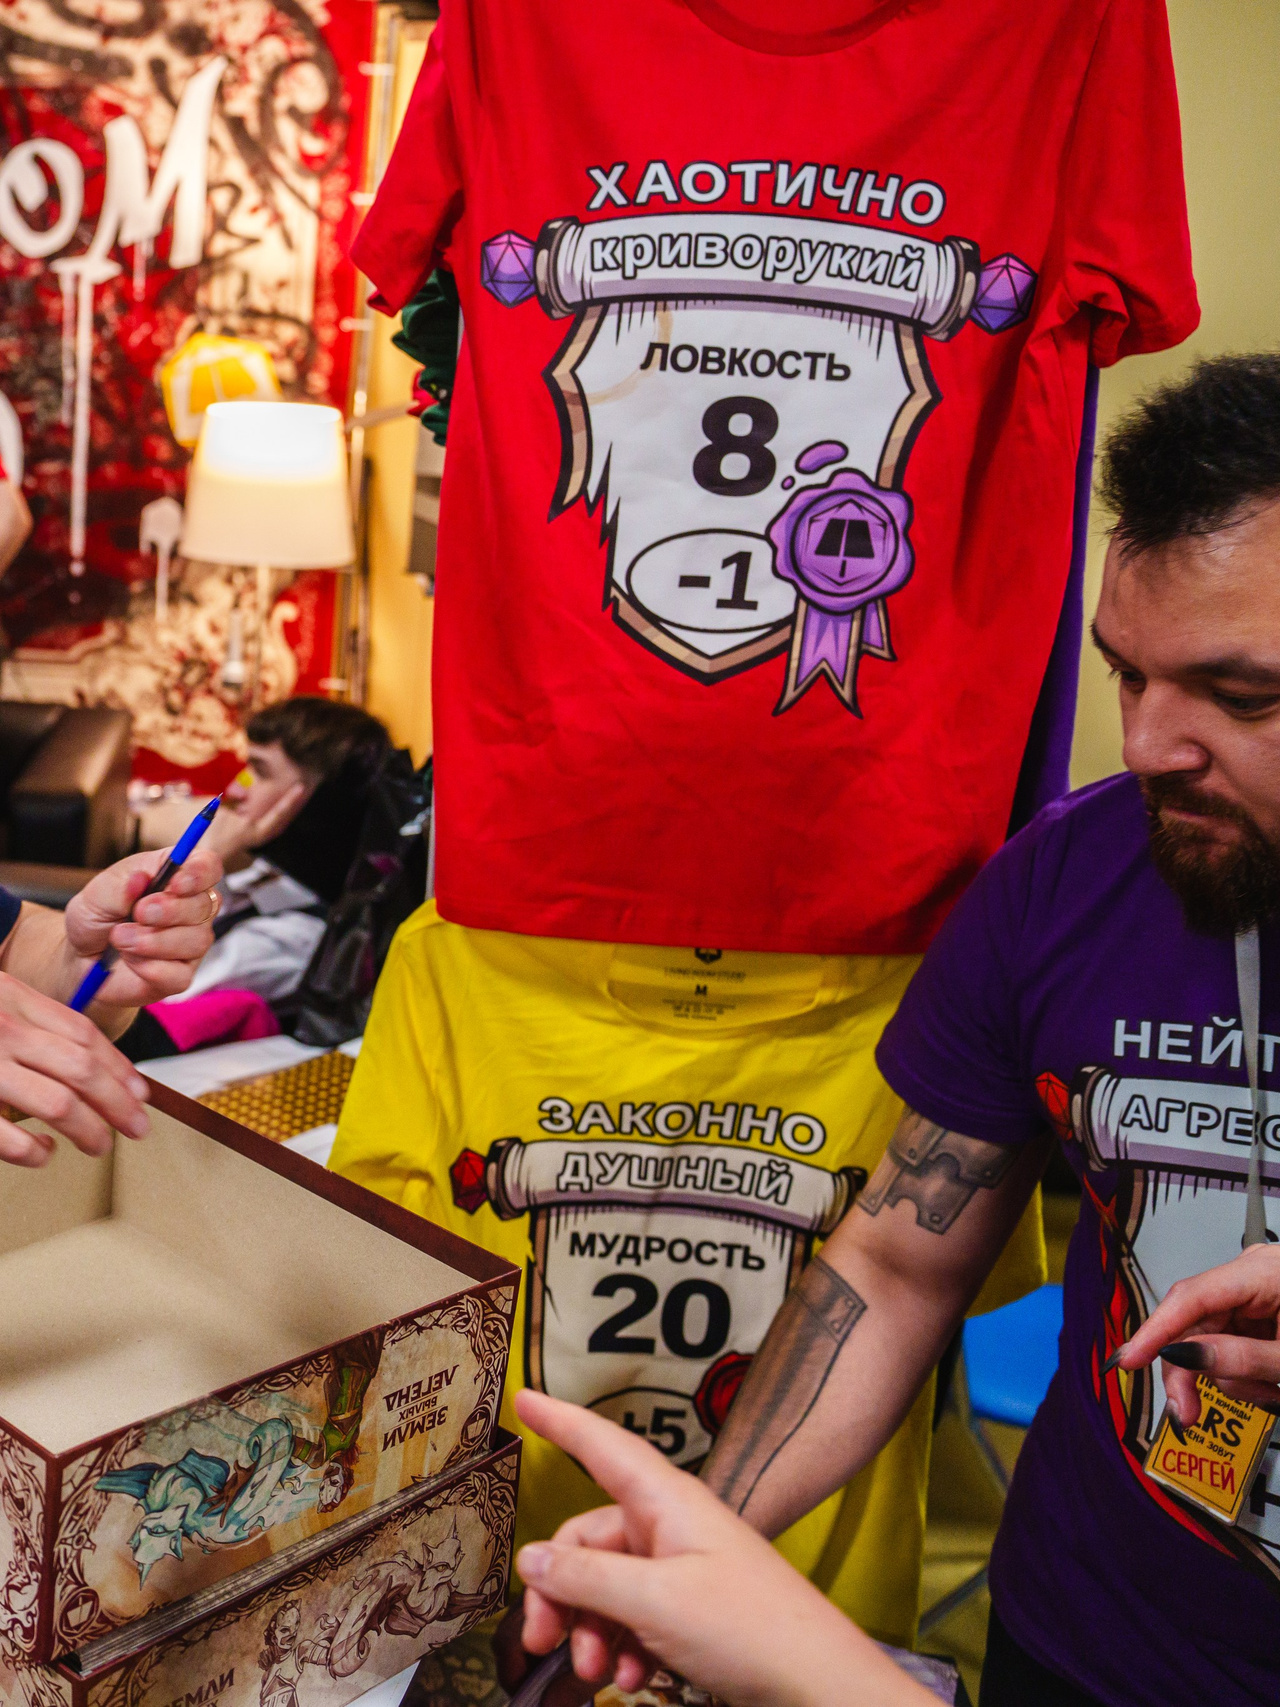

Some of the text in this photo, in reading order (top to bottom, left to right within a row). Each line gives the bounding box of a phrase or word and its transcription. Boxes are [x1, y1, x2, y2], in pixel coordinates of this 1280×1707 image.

[586, 159, 946, 226] ХАОТИЧНО
[590, 233, 926, 292] криворукий
[640, 342, 851, 381] ЛОВКОСТЬ
[692, 395, 779, 496] 8
[678, 551, 759, 611] -1
[538, 1097, 827, 1155] ЗАКОННО
[556, 1152, 794, 1206] ДУШНЫЙ
[569, 1231, 766, 1271] МУДРОСТЬ
[587, 1273, 731, 1360] 20
[382, 1364, 460, 1413] ЛЕГЕНД
[398, 1395, 439, 1422] БЫЛЫХ
[382, 1405, 449, 1452] ЗЕМЛИ
[1206, 1441, 1236, 1461] ЗОВУТ
[1162, 1449, 1236, 1495] СЕРГЕЙ
